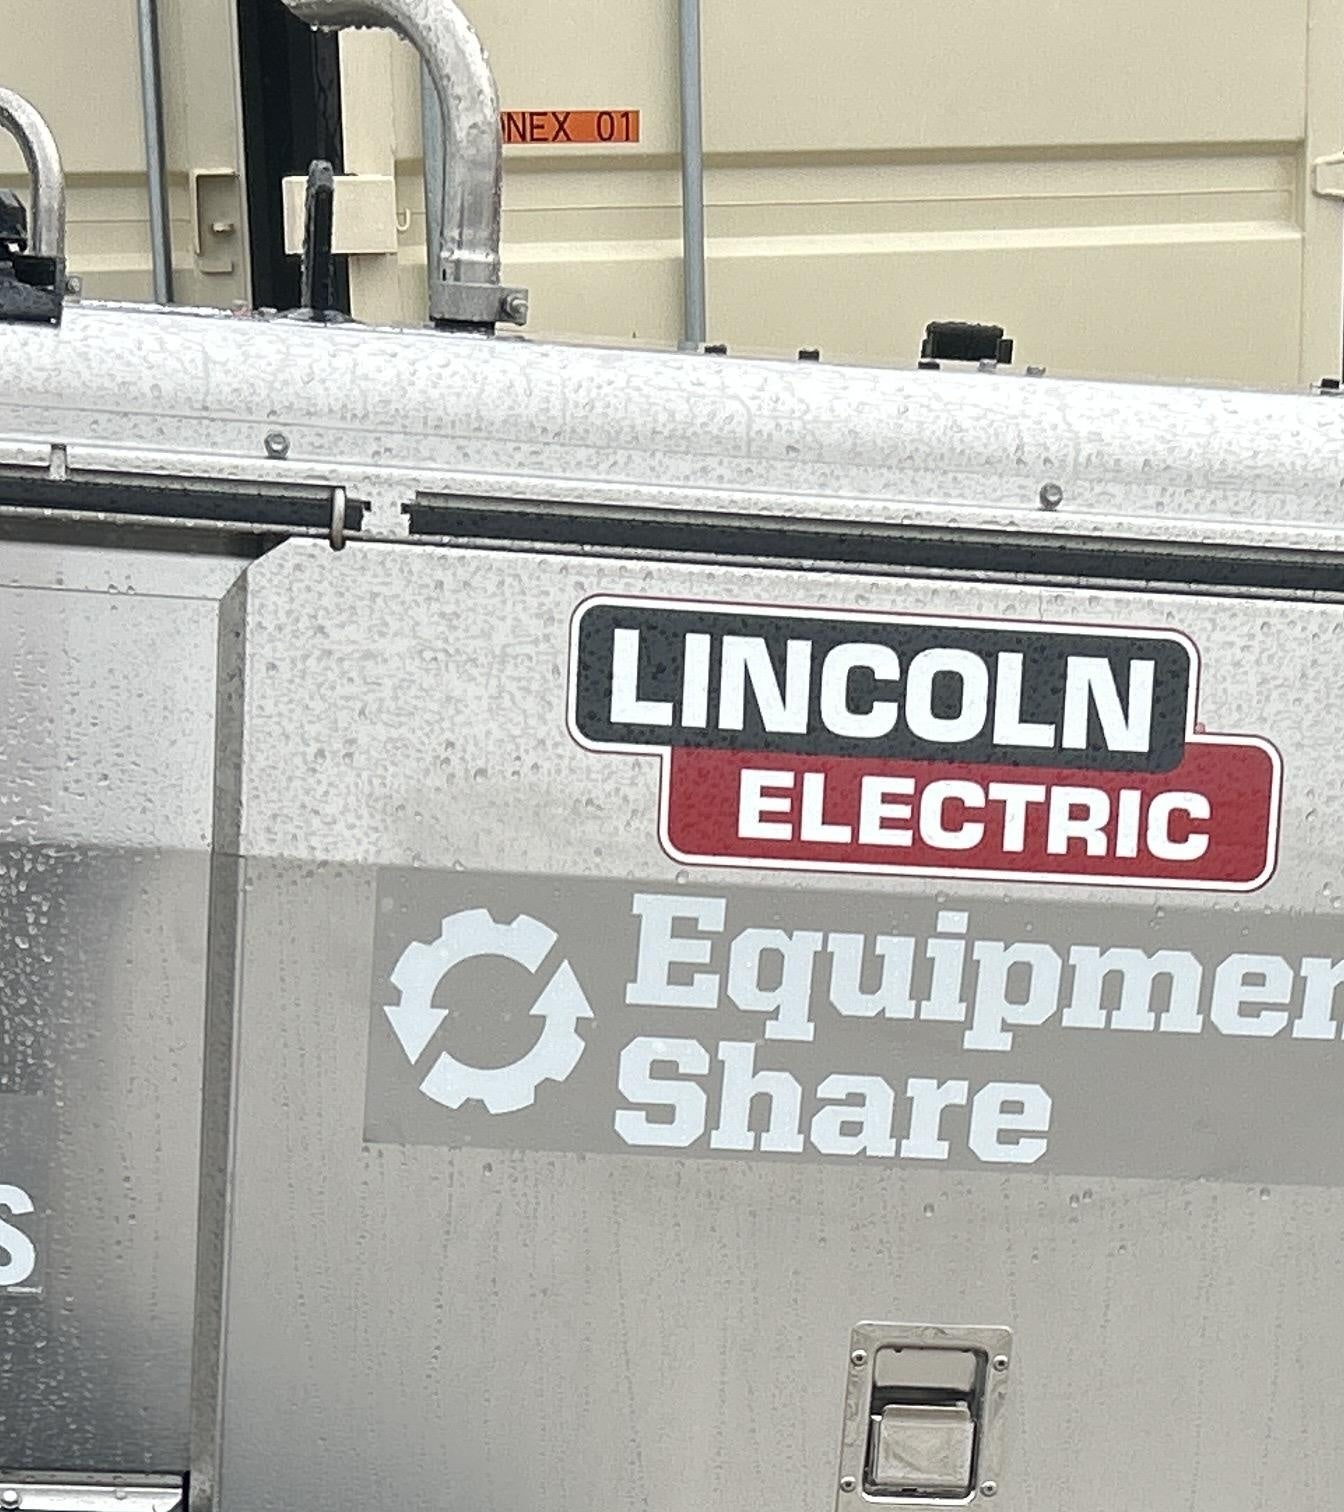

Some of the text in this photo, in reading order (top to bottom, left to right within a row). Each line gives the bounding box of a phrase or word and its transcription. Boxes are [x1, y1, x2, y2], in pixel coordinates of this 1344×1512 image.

[501, 111, 633, 143] NEX 01
[609, 628, 1155, 754] LINCOLN
[737, 769, 1212, 861] ELECTRIC
[612, 1035, 1053, 1165] Share
